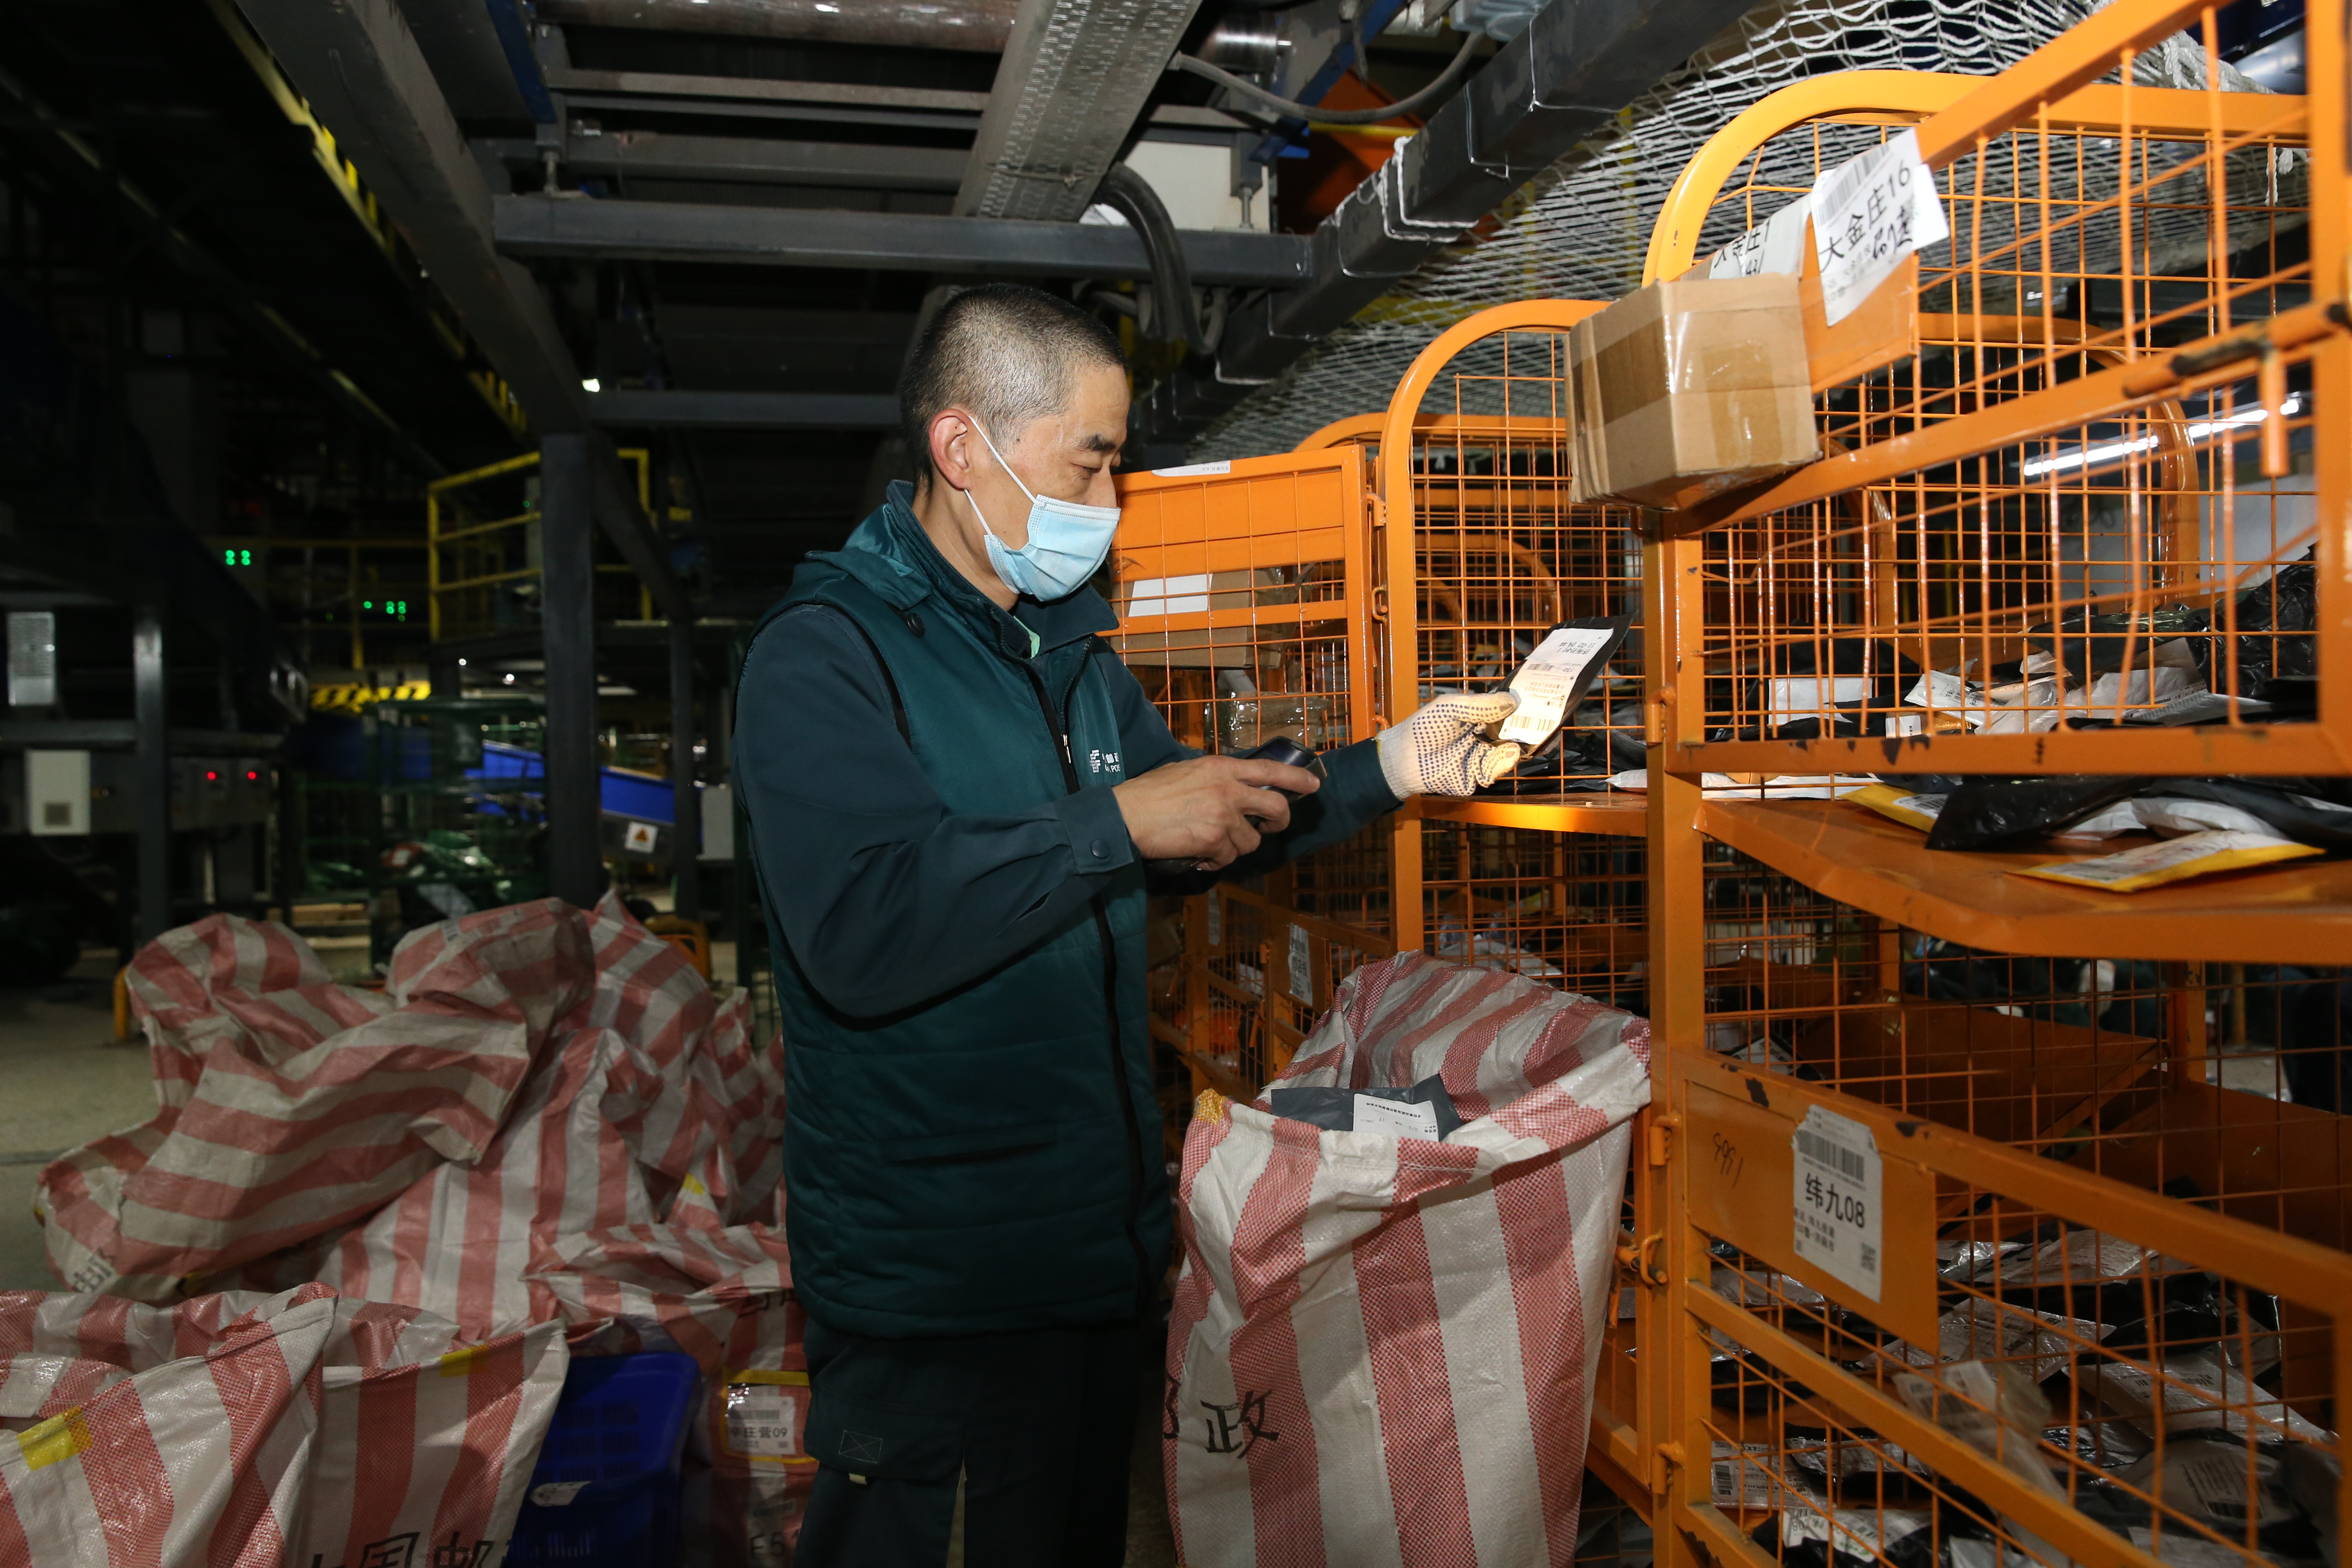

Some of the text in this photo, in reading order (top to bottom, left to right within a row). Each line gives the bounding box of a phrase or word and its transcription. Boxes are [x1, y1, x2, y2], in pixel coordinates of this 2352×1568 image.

[1818, 166, 1911, 272] 大金庄16
[1805, 1172, 1865, 1229] 纬九08
